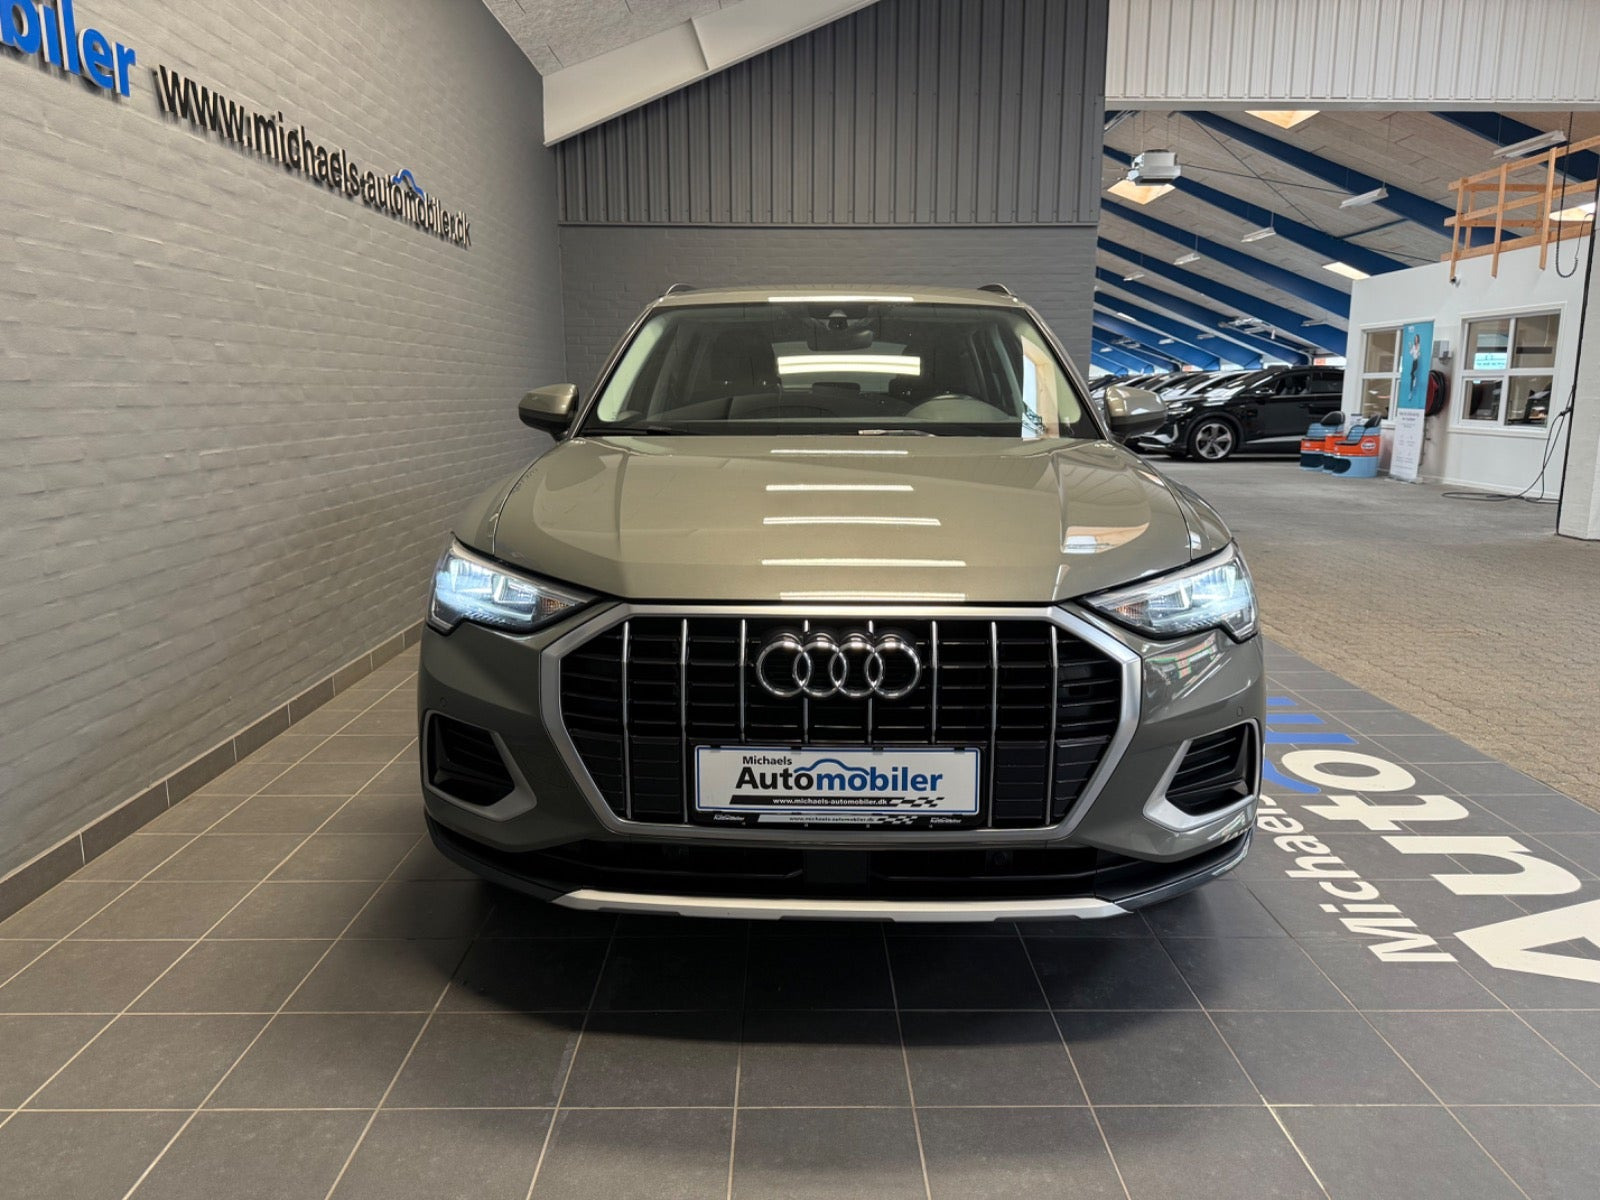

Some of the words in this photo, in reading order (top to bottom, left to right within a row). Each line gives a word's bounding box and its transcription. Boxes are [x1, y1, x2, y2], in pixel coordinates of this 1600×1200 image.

[156, 64, 471, 247] www.michaels-automobiler.dk
[742, 756, 792, 766] Michaels
[735, 766, 943, 791] Automobiler
[772, 797, 888, 806] www.michaels-automobiler.dk
